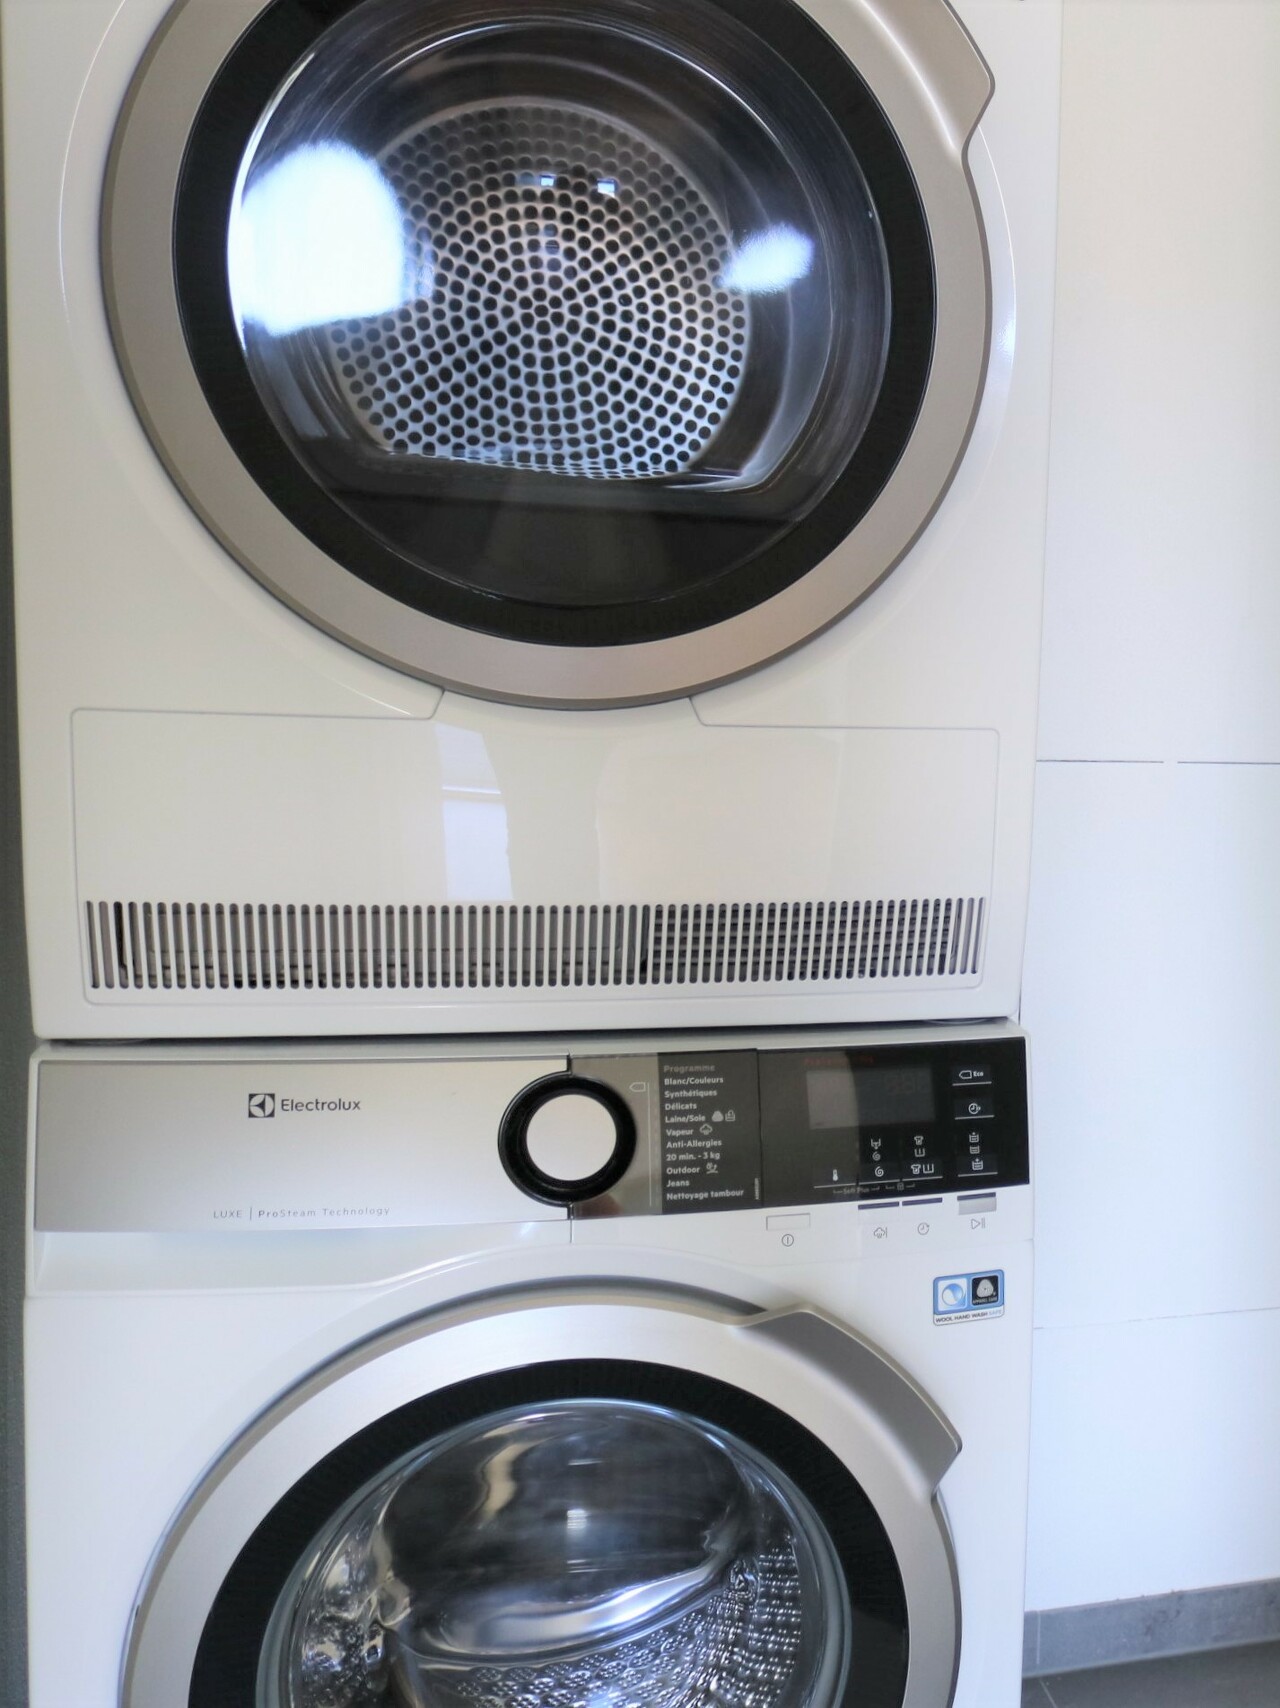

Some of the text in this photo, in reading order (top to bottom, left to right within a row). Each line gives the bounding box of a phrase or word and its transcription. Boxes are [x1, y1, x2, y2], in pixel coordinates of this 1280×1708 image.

[663, 1065, 715, 1074] Programme
[664, 1077, 724, 1086] Blanc/Couleurs
[664, 1089, 718, 1099] Synthétiques
[280, 1098, 361, 1112] Electrolux
[664, 1103, 698, 1111] Délicats
[665, 1114, 706, 1123] Laine/Soie
[666, 1128, 694, 1137] Vapeur
[666, 1139, 722, 1149] Anti-Allergies
[666, 1153, 677, 1161] 20
[703, 1151, 709, 1159] 3
[709, 1151, 721, 1160] kg
[666, 1166, 700, 1175] Outdoor
[666, 1179, 690, 1187] Jeans
[666, 1191, 709, 1200] Nettoyage
[710, 1188, 744, 1198] tambour
[213, 1205, 391, 1219] LUXE ProSteam Technology
